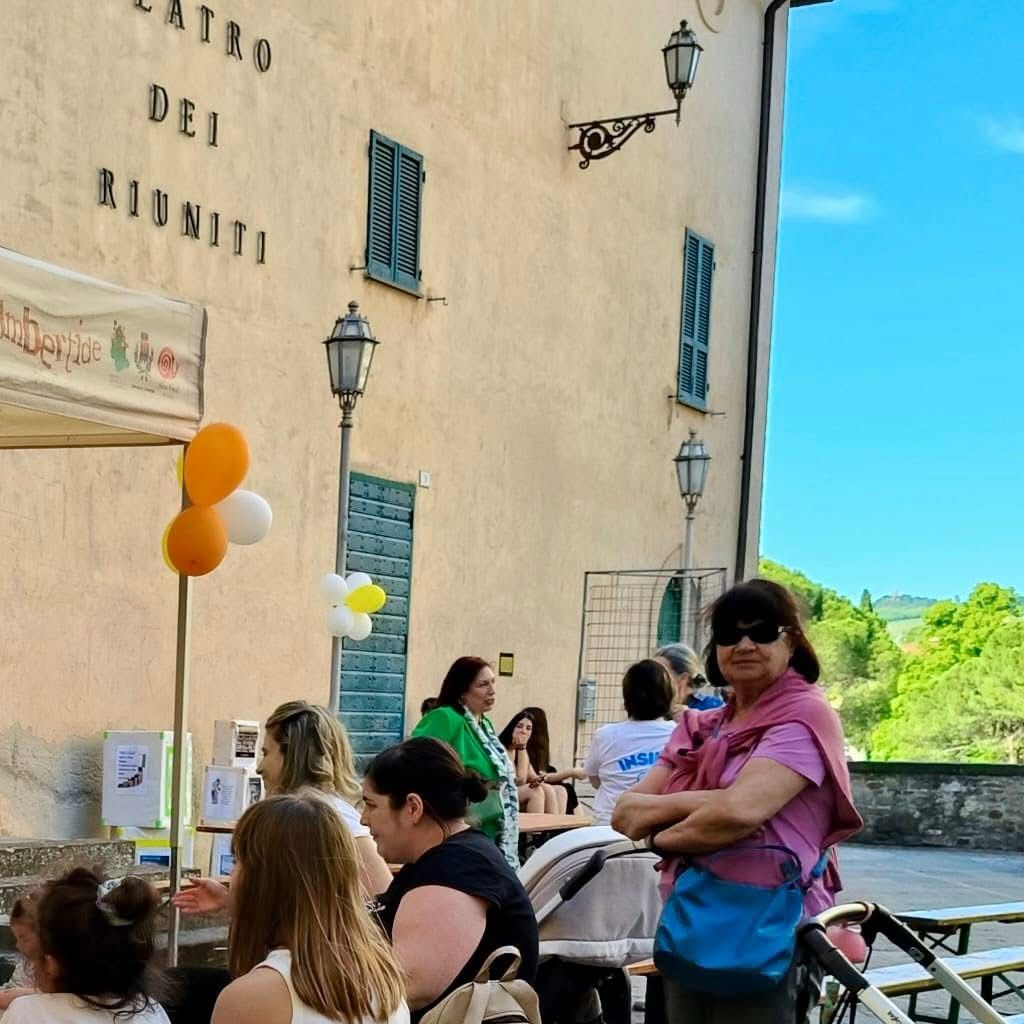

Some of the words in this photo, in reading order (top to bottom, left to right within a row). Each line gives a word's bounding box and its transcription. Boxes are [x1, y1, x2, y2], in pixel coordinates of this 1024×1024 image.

[135, 0, 271, 72] ATRO
[149, 84, 219, 147] DEI
[99, 168, 266, 264] RIUNITI
[618, 751, 661, 771] INSI
